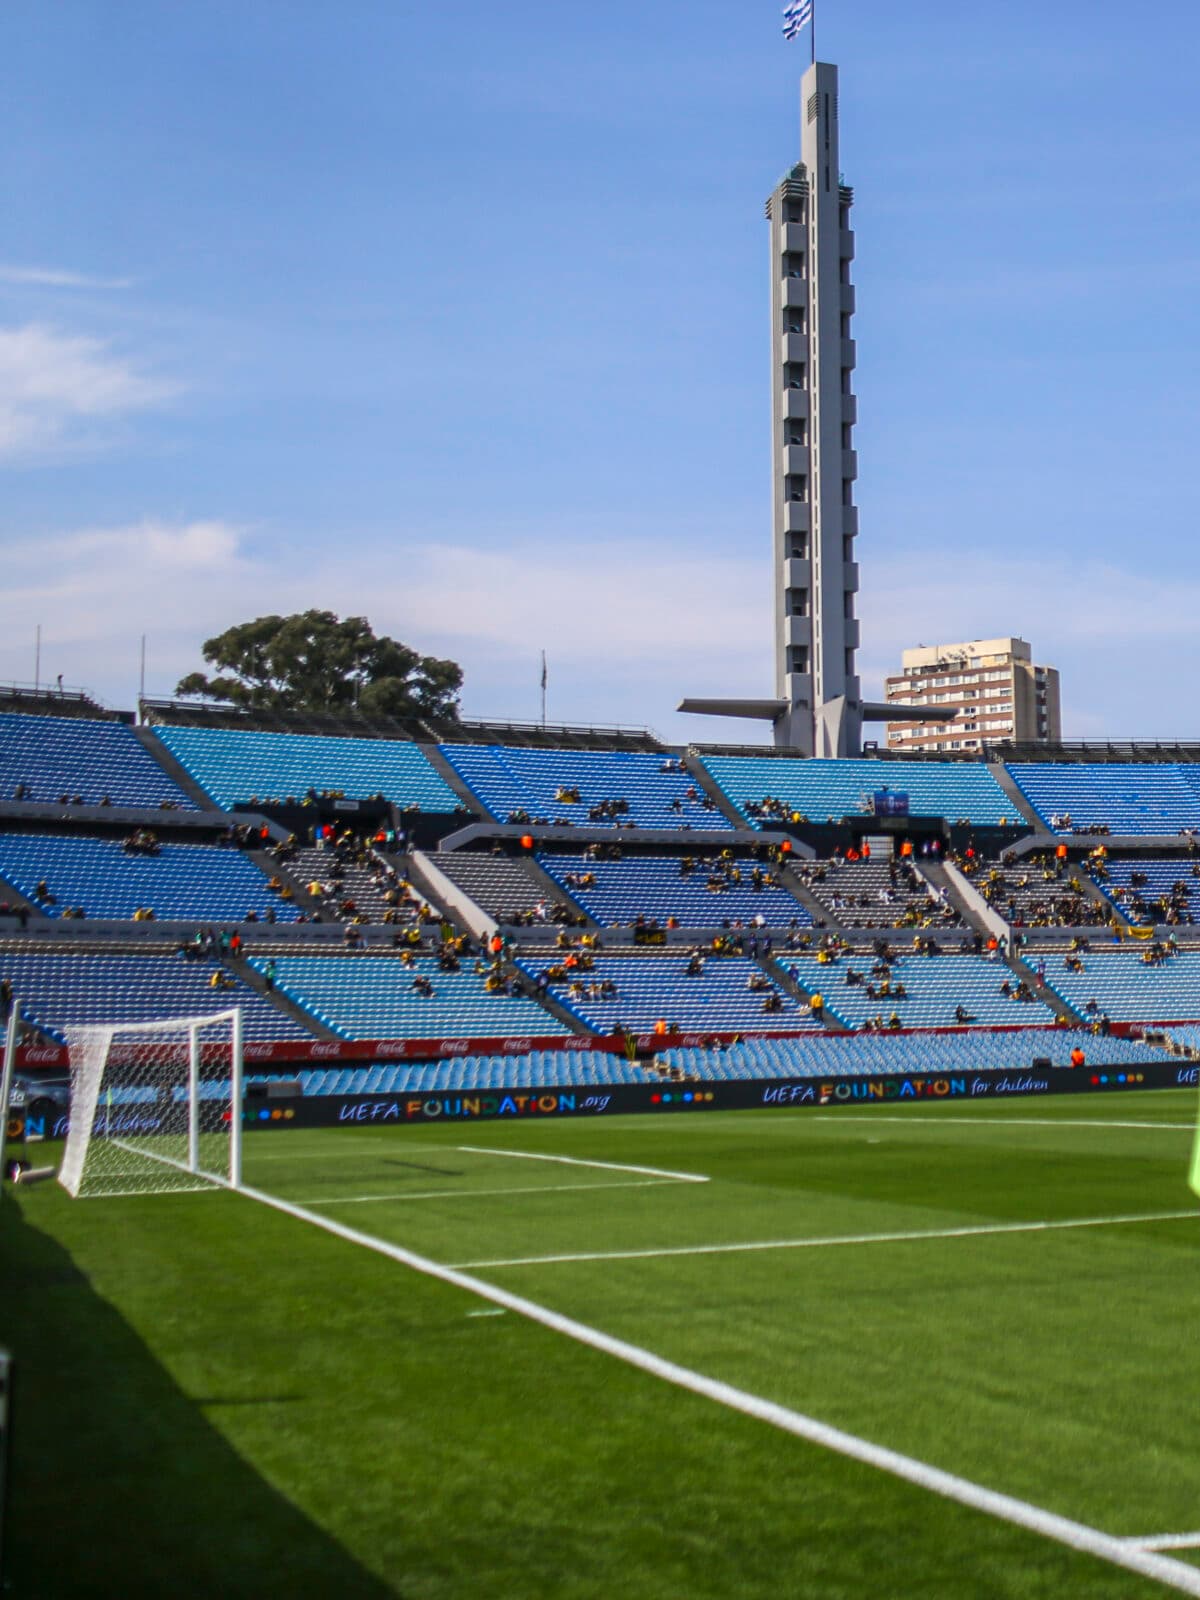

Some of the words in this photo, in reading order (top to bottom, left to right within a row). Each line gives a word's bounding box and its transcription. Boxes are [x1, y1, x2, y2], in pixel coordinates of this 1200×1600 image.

[310, 1042, 340, 1055] Coca-Cola
[376, 1041, 405, 1054] Coca-Cola
[440, 1040, 470, 1052] Coca-Cola
[503, 1039, 531, 1050] Coca-Cola
[564, 1038, 592, 1049] Coca-Cola
[763, 1085, 816, 1103] UEFA
[820, 1078, 967, 1101] FOUNDATION
[971, 1077, 990, 1096] for
[996, 1076, 1049, 1093] children
[339, 1102, 401, 1120] UEFA
[406, 1094, 576, 1119] FOUNDATION
[580, 1095, 612, 1111] .org
